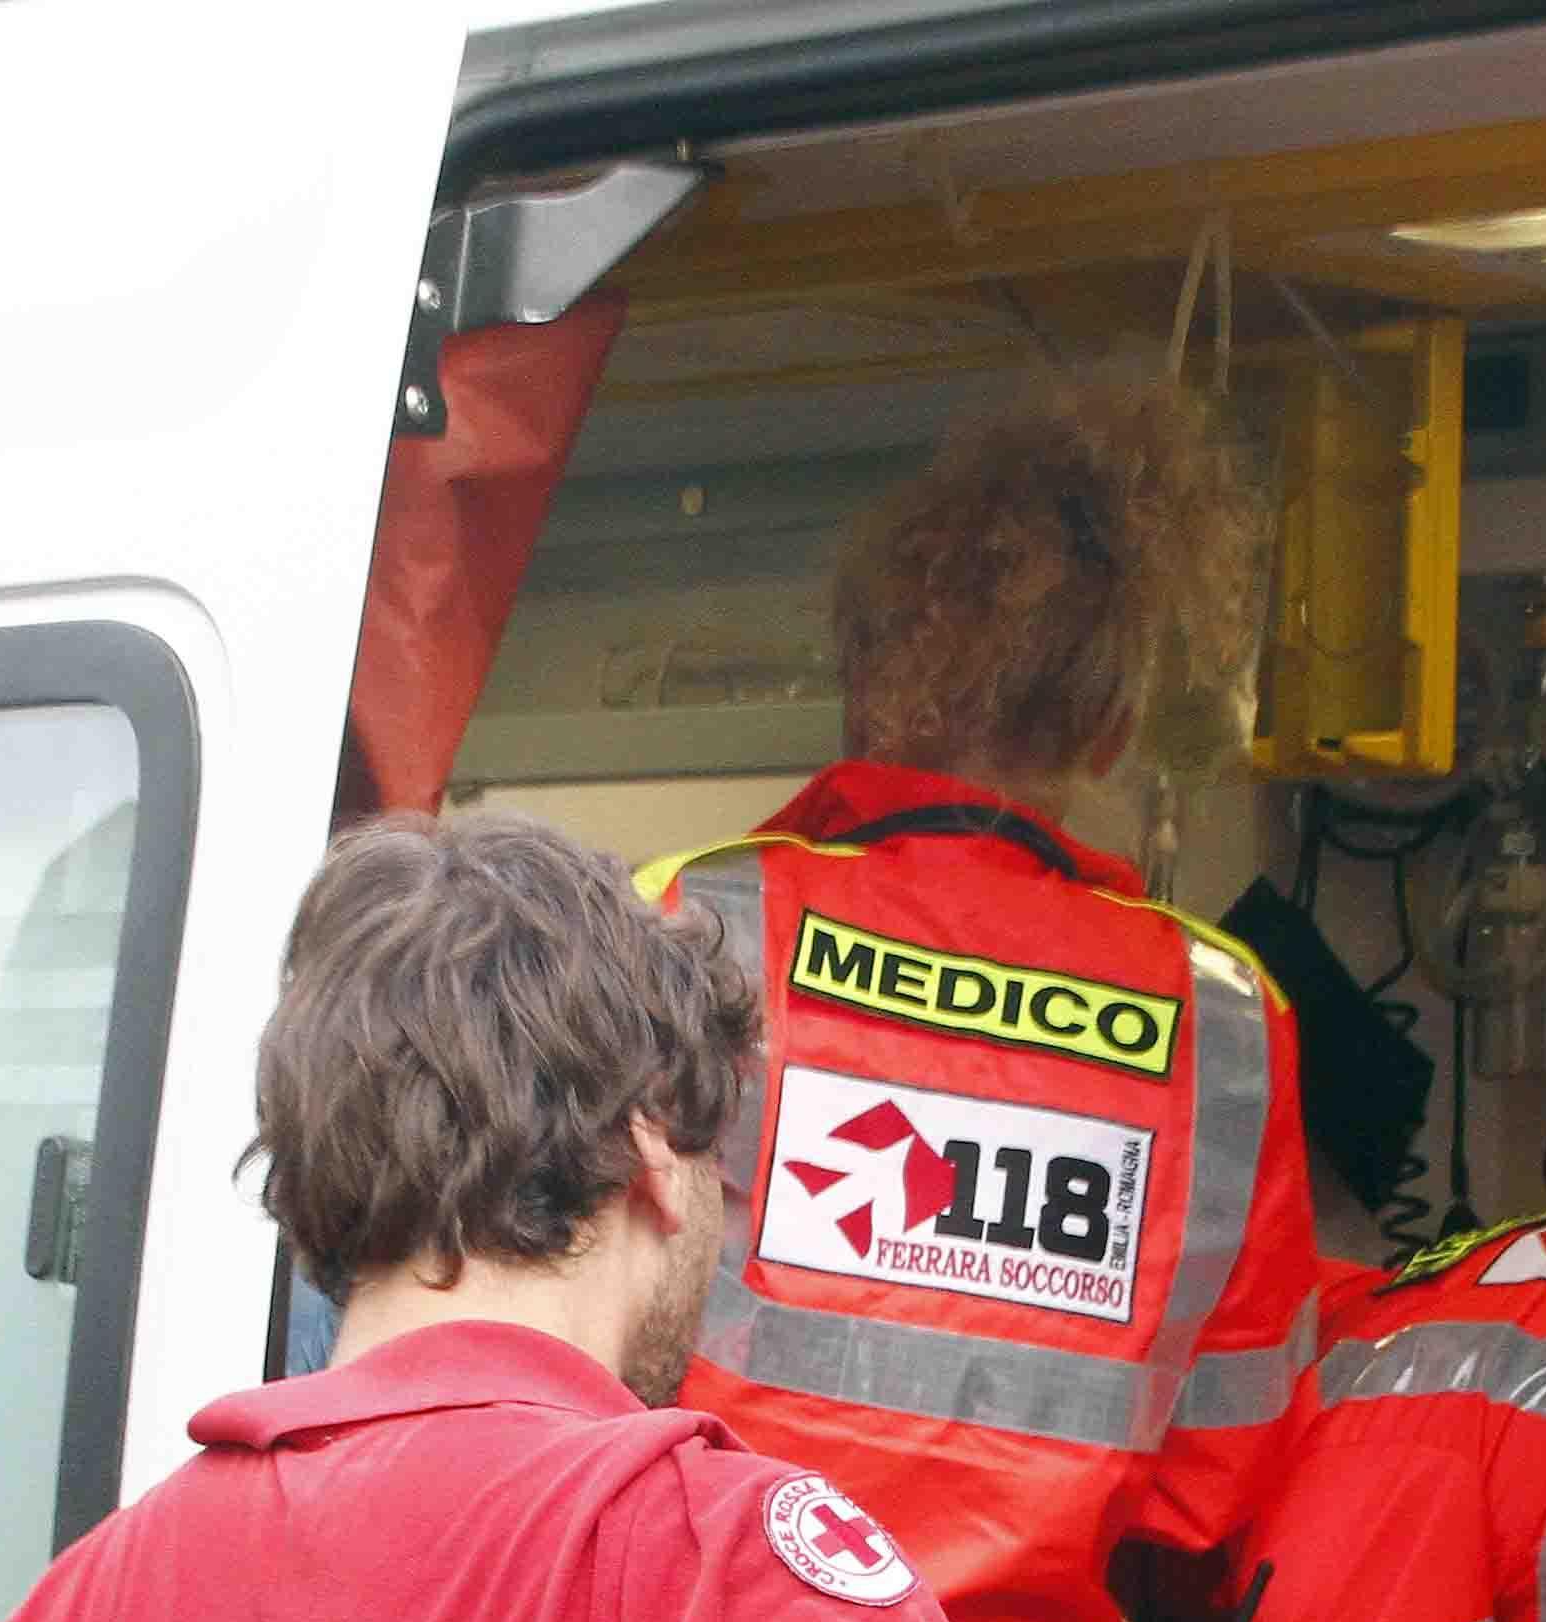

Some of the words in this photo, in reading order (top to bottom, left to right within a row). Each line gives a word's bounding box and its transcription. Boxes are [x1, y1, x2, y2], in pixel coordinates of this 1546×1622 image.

[806, 928, 1160, 1056] MEDICO
[934, 1139, 1112, 1263] 118
[876, 1238, 992, 1284] FERRARA
[1000, 1257, 1125, 1309] SOCCORSO
[778, 1529, 835, 1585] CROCE
